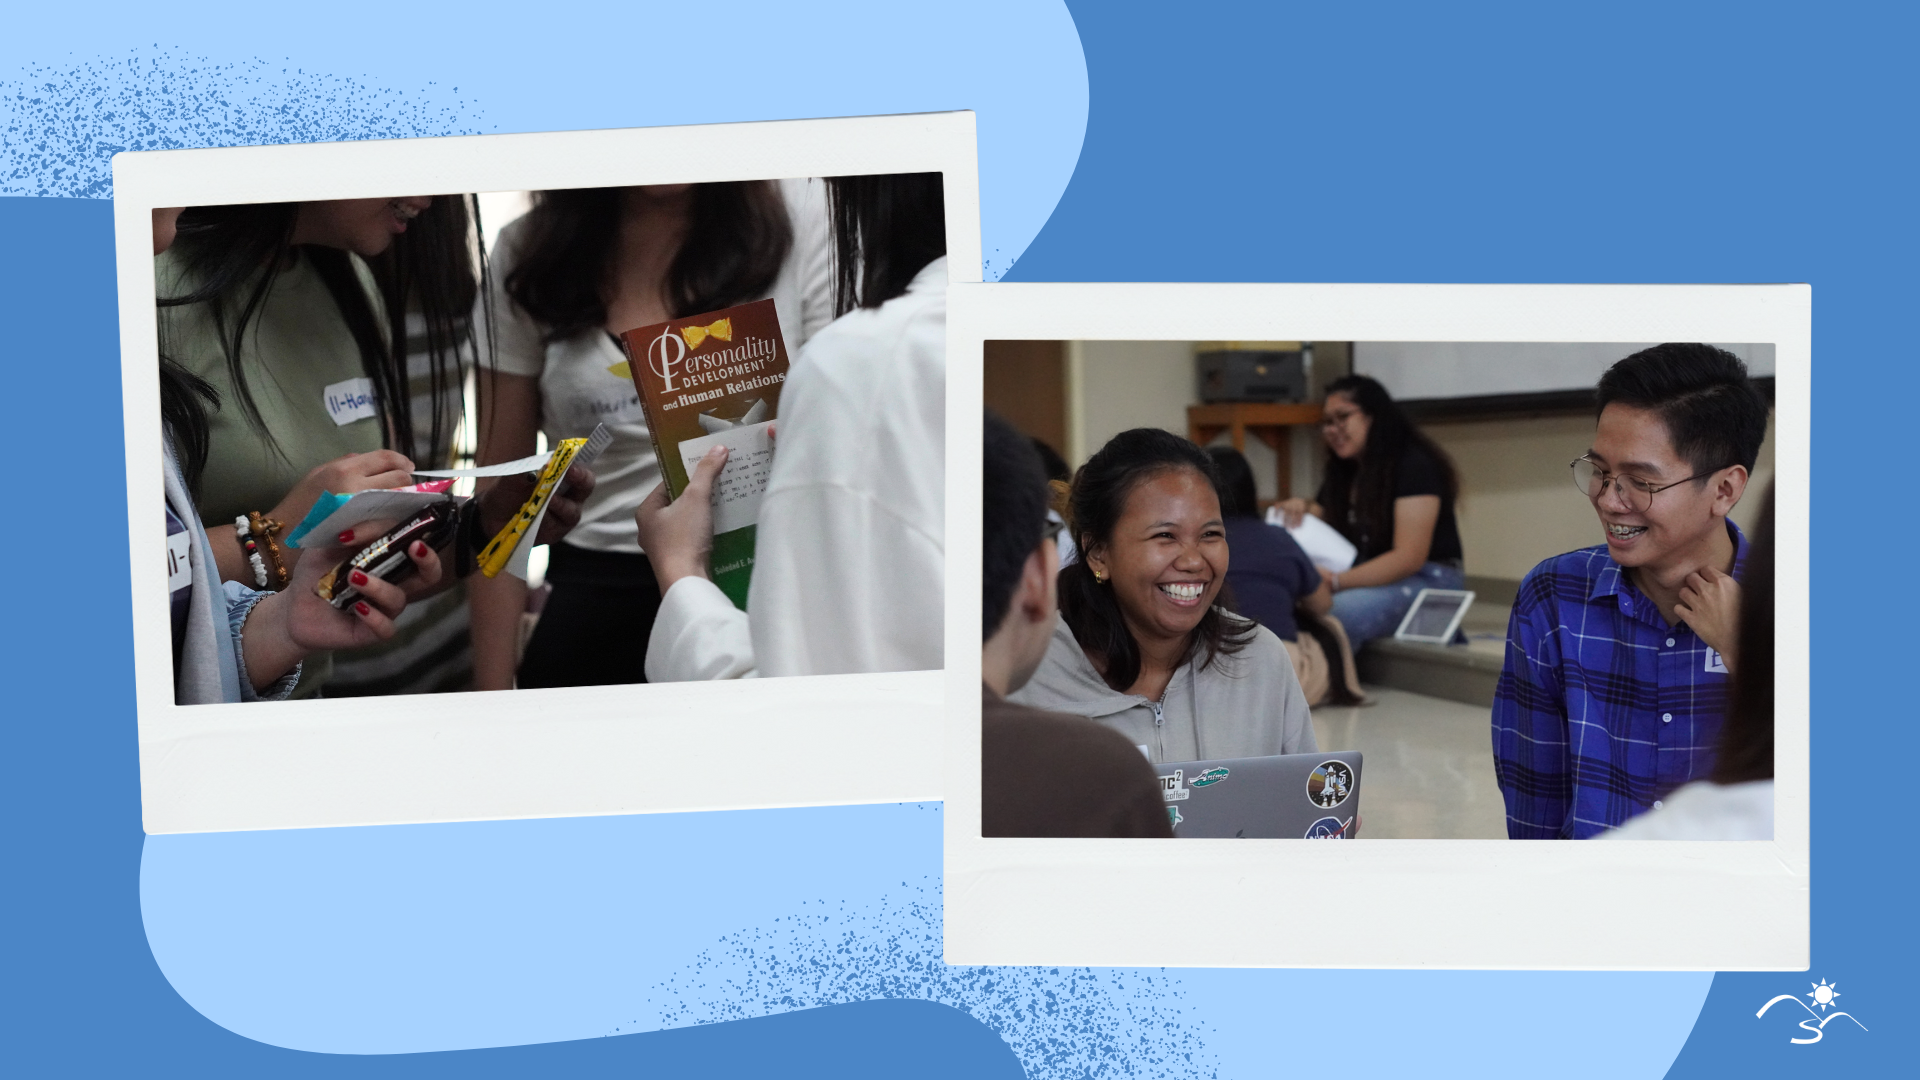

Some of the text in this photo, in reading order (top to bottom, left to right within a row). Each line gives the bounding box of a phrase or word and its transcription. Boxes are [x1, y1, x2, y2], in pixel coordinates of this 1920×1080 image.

[648, 325, 776, 394] Personality
[682, 359, 765, 388] DEVELOPMENT
[663, 371, 786, 411] and Human Relations
[1338, 769, 1347, 797] NASA
